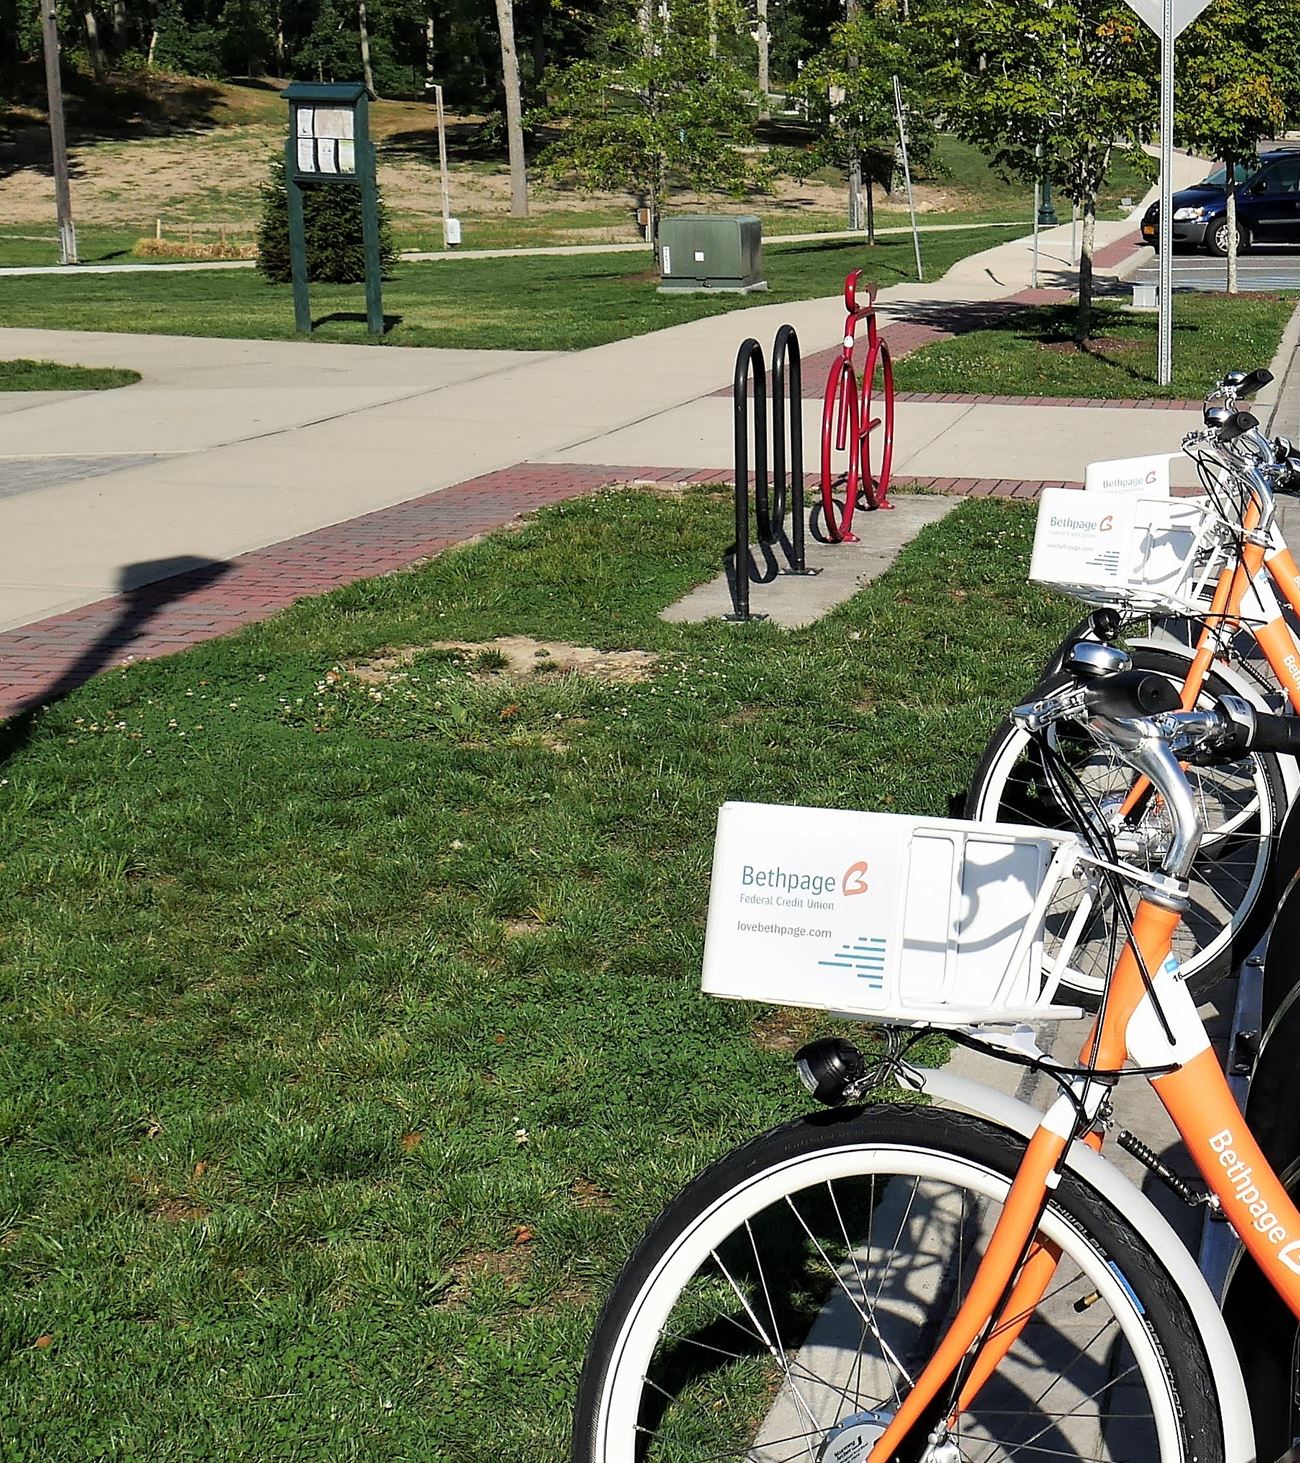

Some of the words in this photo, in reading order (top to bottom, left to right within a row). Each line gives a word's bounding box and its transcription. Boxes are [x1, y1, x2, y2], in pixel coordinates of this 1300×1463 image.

[1050, 517, 1097, 531] Bethpage
[742, 865, 836, 895] Bethpage
[739, 893, 773, 906] Federal
[776, 896, 804, 909] Credit
[807, 898, 834, 911] Union
[737, 920, 832, 939] lovebethpage.com
[1209, 1129, 1286, 1244] Bethpage
[1047, 1198, 1108, 1257] CHWALBE
[1145, 1320, 1184, 1418] MARATHON
